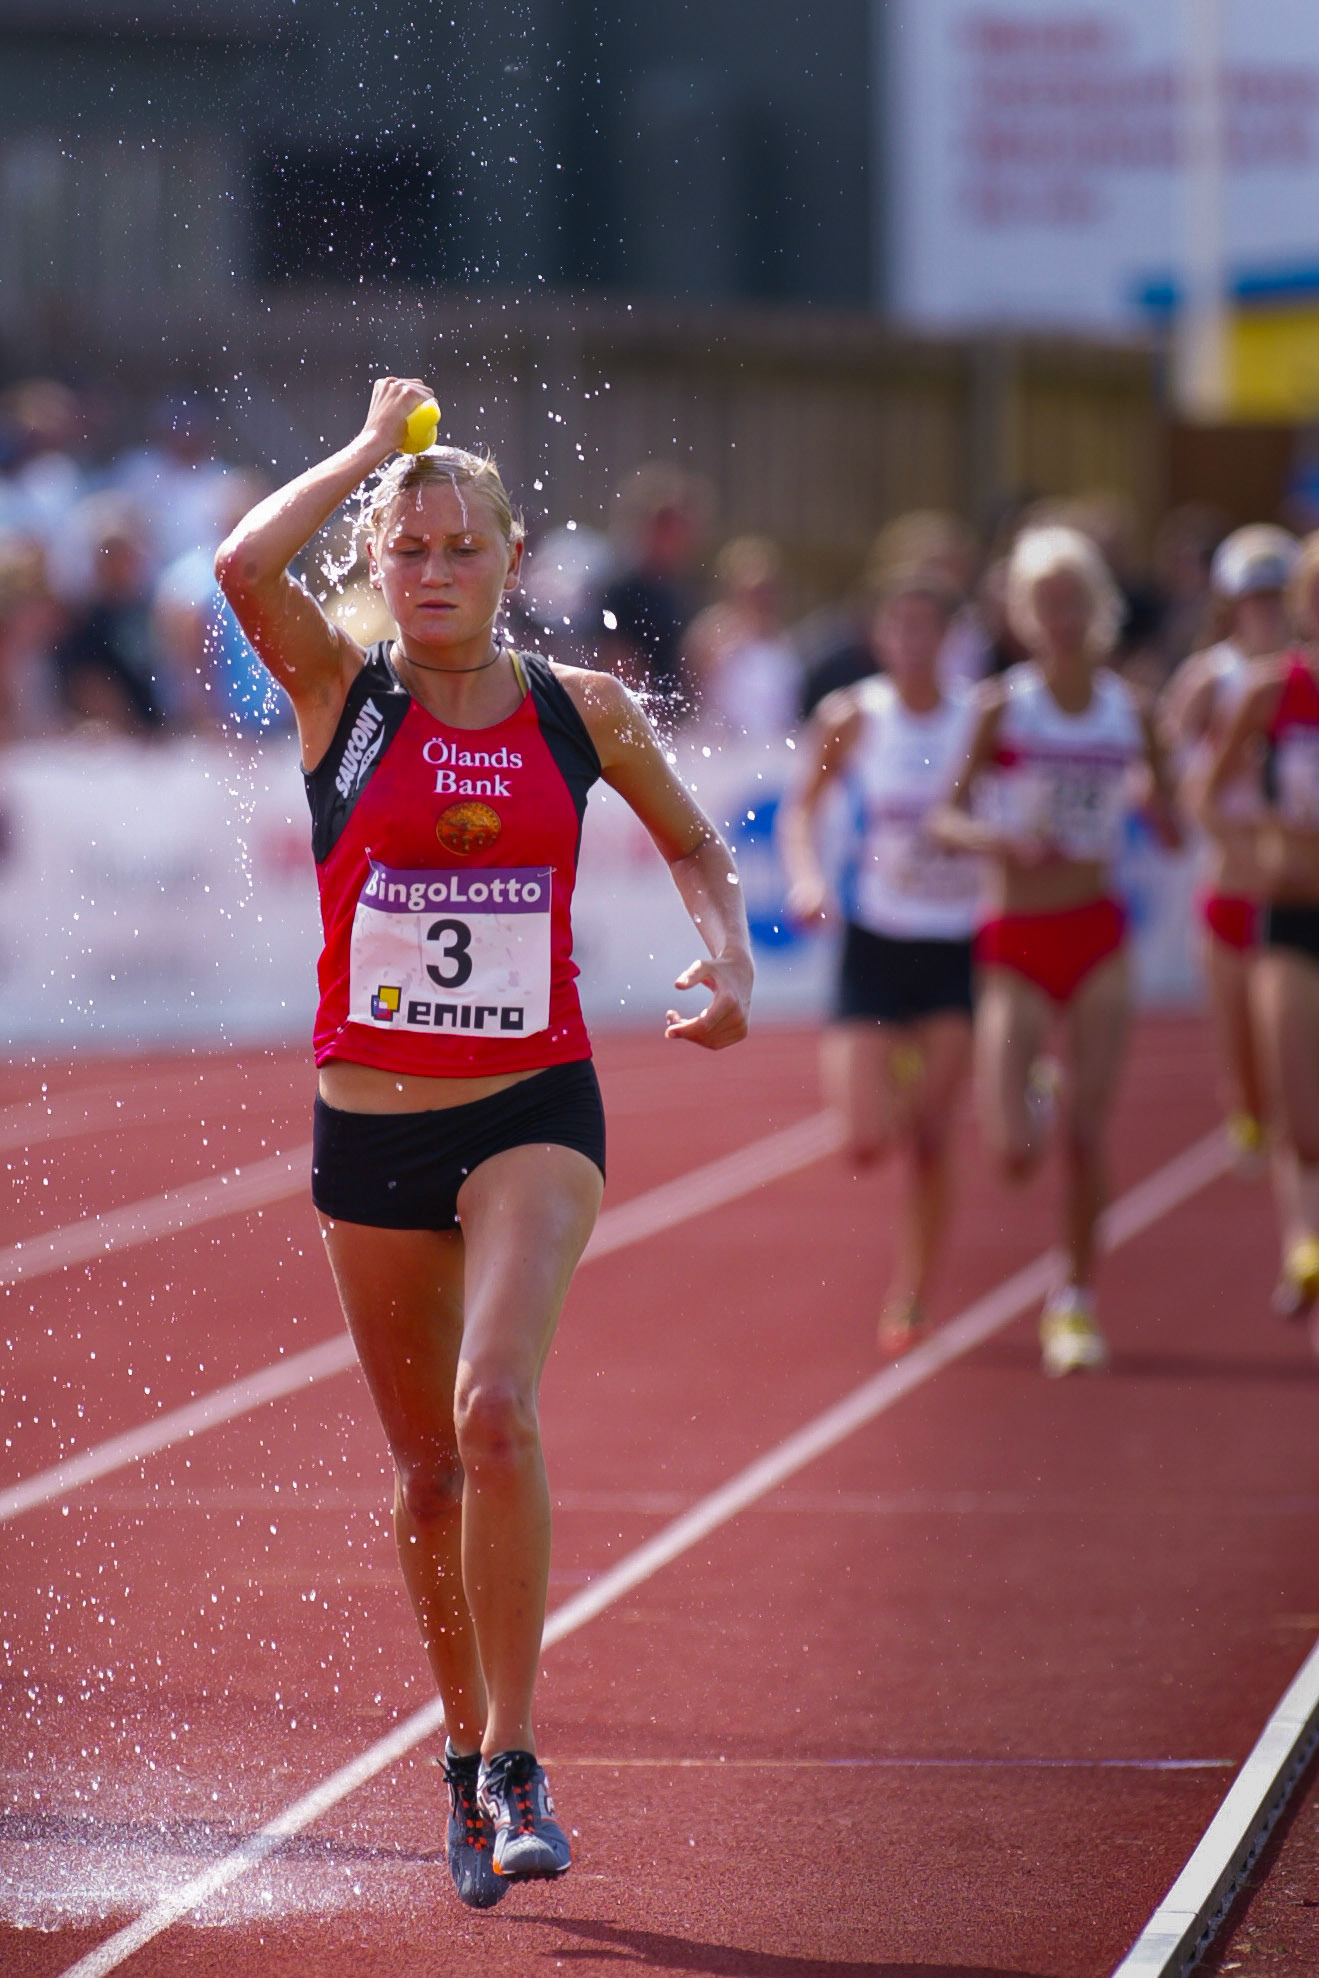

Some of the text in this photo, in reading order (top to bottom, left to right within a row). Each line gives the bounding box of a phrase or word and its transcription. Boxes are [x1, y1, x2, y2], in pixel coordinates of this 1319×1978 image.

[335, 697, 384, 799] SAUCONY
[422, 737, 523, 769] Ölands
[433, 770, 512, 797] Bank
[365, 870, 541, 911] BingoLotto
[426, 919, 473, 988] 3
